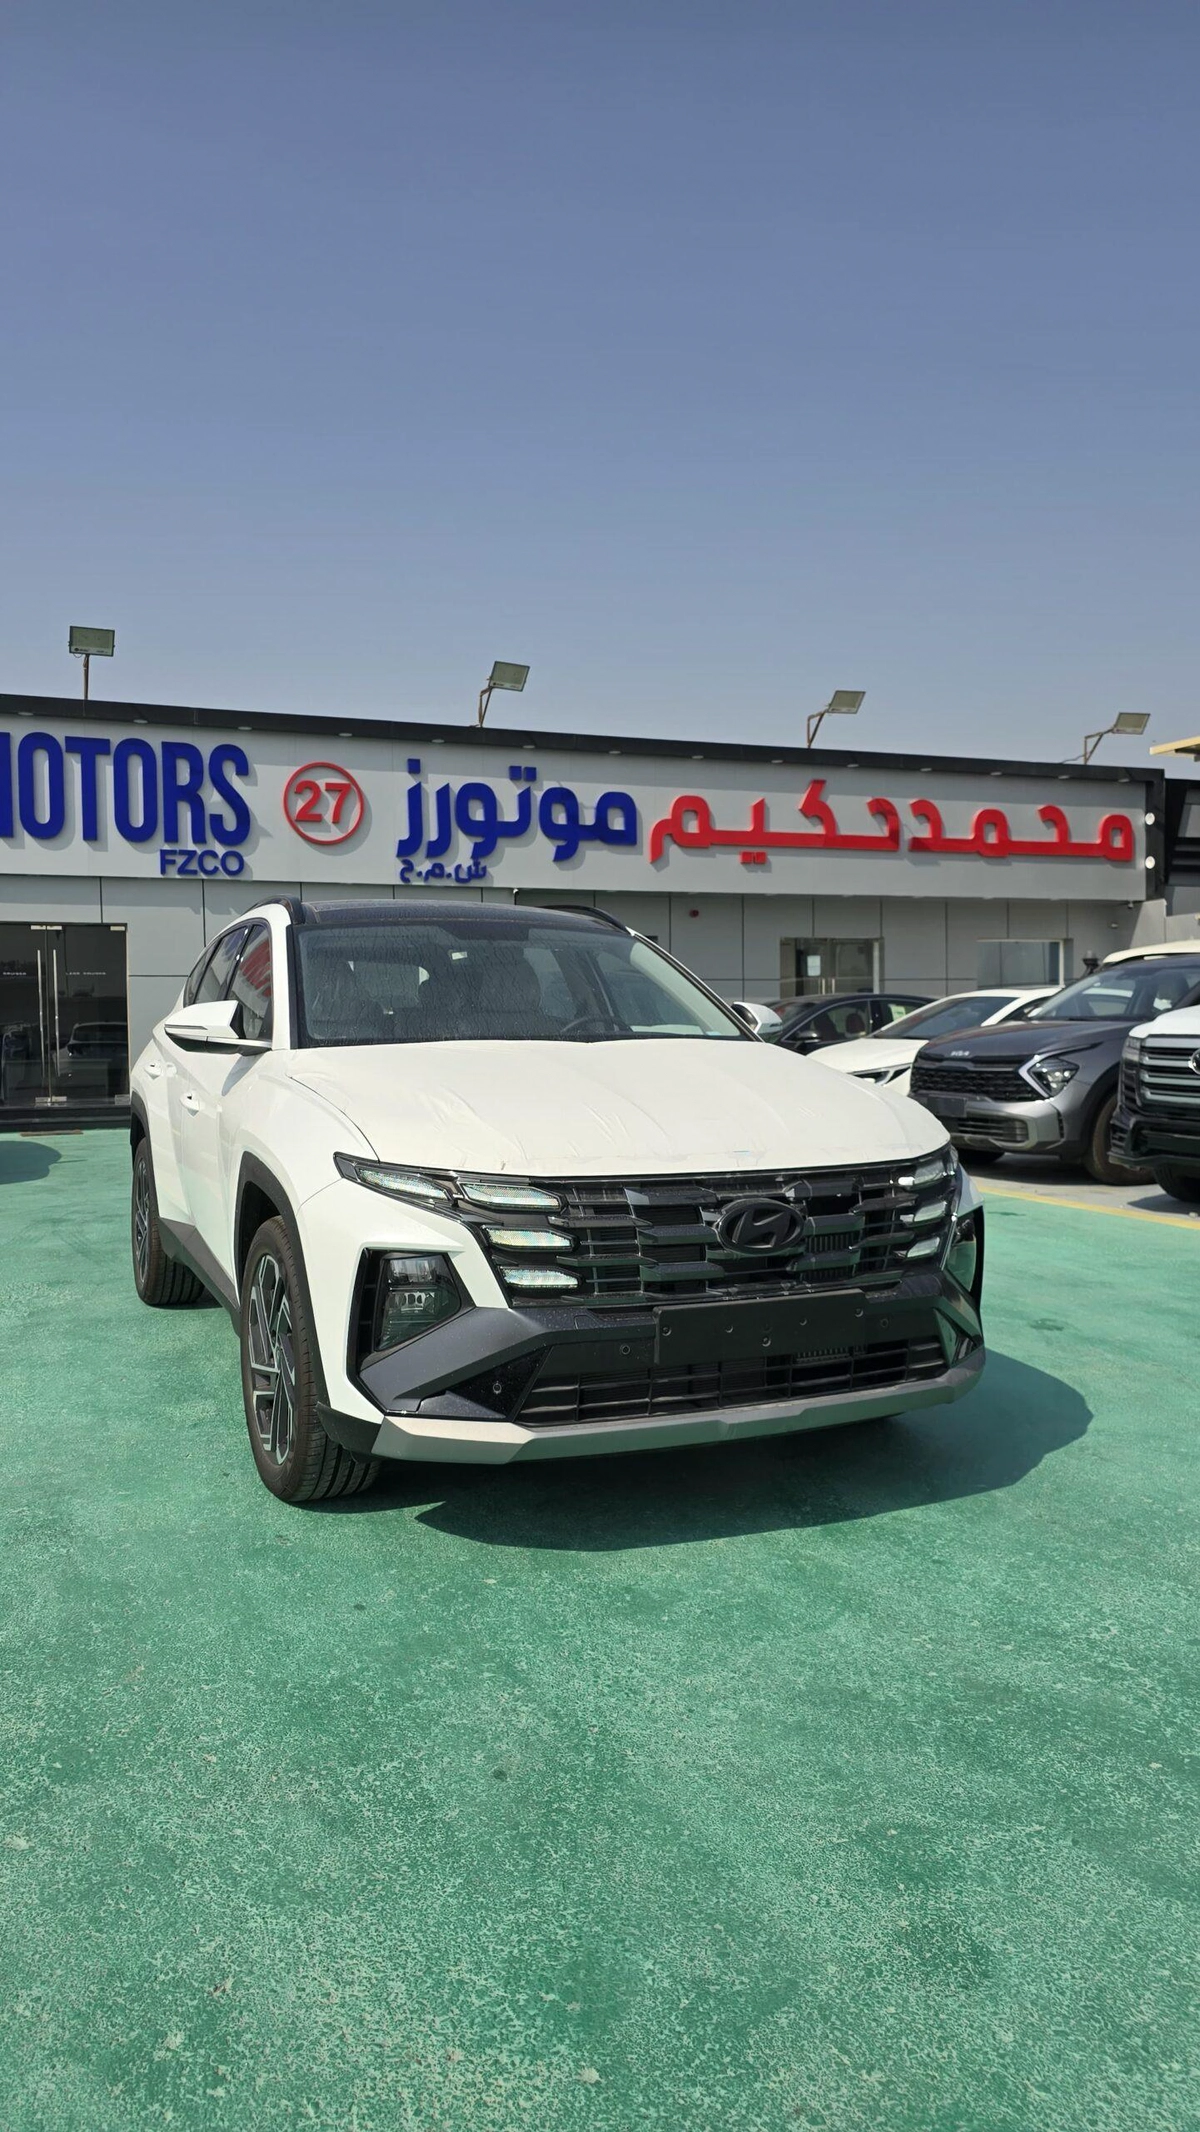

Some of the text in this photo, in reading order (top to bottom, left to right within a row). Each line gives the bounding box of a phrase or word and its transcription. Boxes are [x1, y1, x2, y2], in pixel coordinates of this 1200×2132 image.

[0, 731, 251, 847] OTORS
[294, 780, 352, 824] 27
[396, 758, 1134, 864] محمد حكيم موتورز
[160, 849, 245, 876] FZCO
